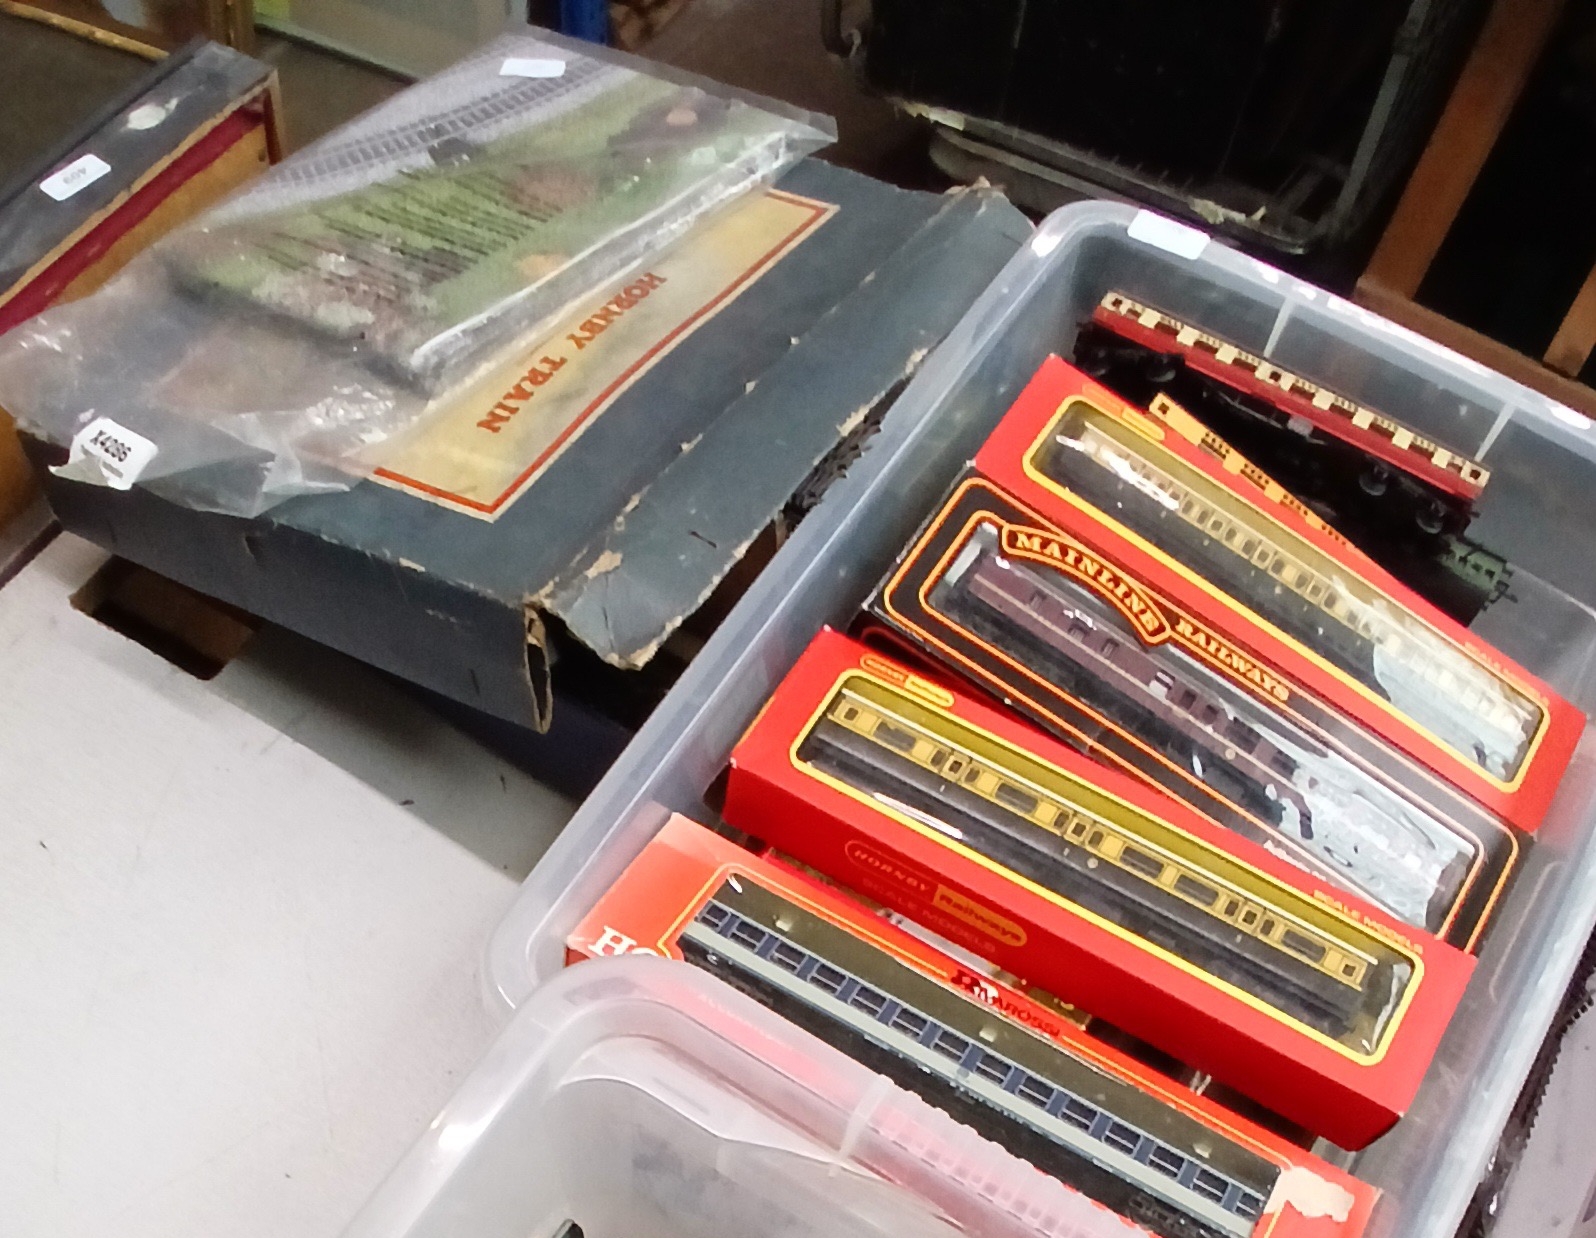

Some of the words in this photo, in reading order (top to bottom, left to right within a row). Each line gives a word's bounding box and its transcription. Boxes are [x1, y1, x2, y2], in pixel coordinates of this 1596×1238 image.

[566, 272, 667, 350] HORNBY
[477, 356, 568, 433] TRAIN
[1015, 532, 1161, 632] MAINLINE
[1175, 618, 1290, 701] RAILWAYS
[854, 850, 930, 892] HORNBY
[939, 893, 1022, 942] Railways
[862, 877, 918, 911] SCALE
[922, 909, 996, 954] MODELS
[587, 925, 660, 957] H
